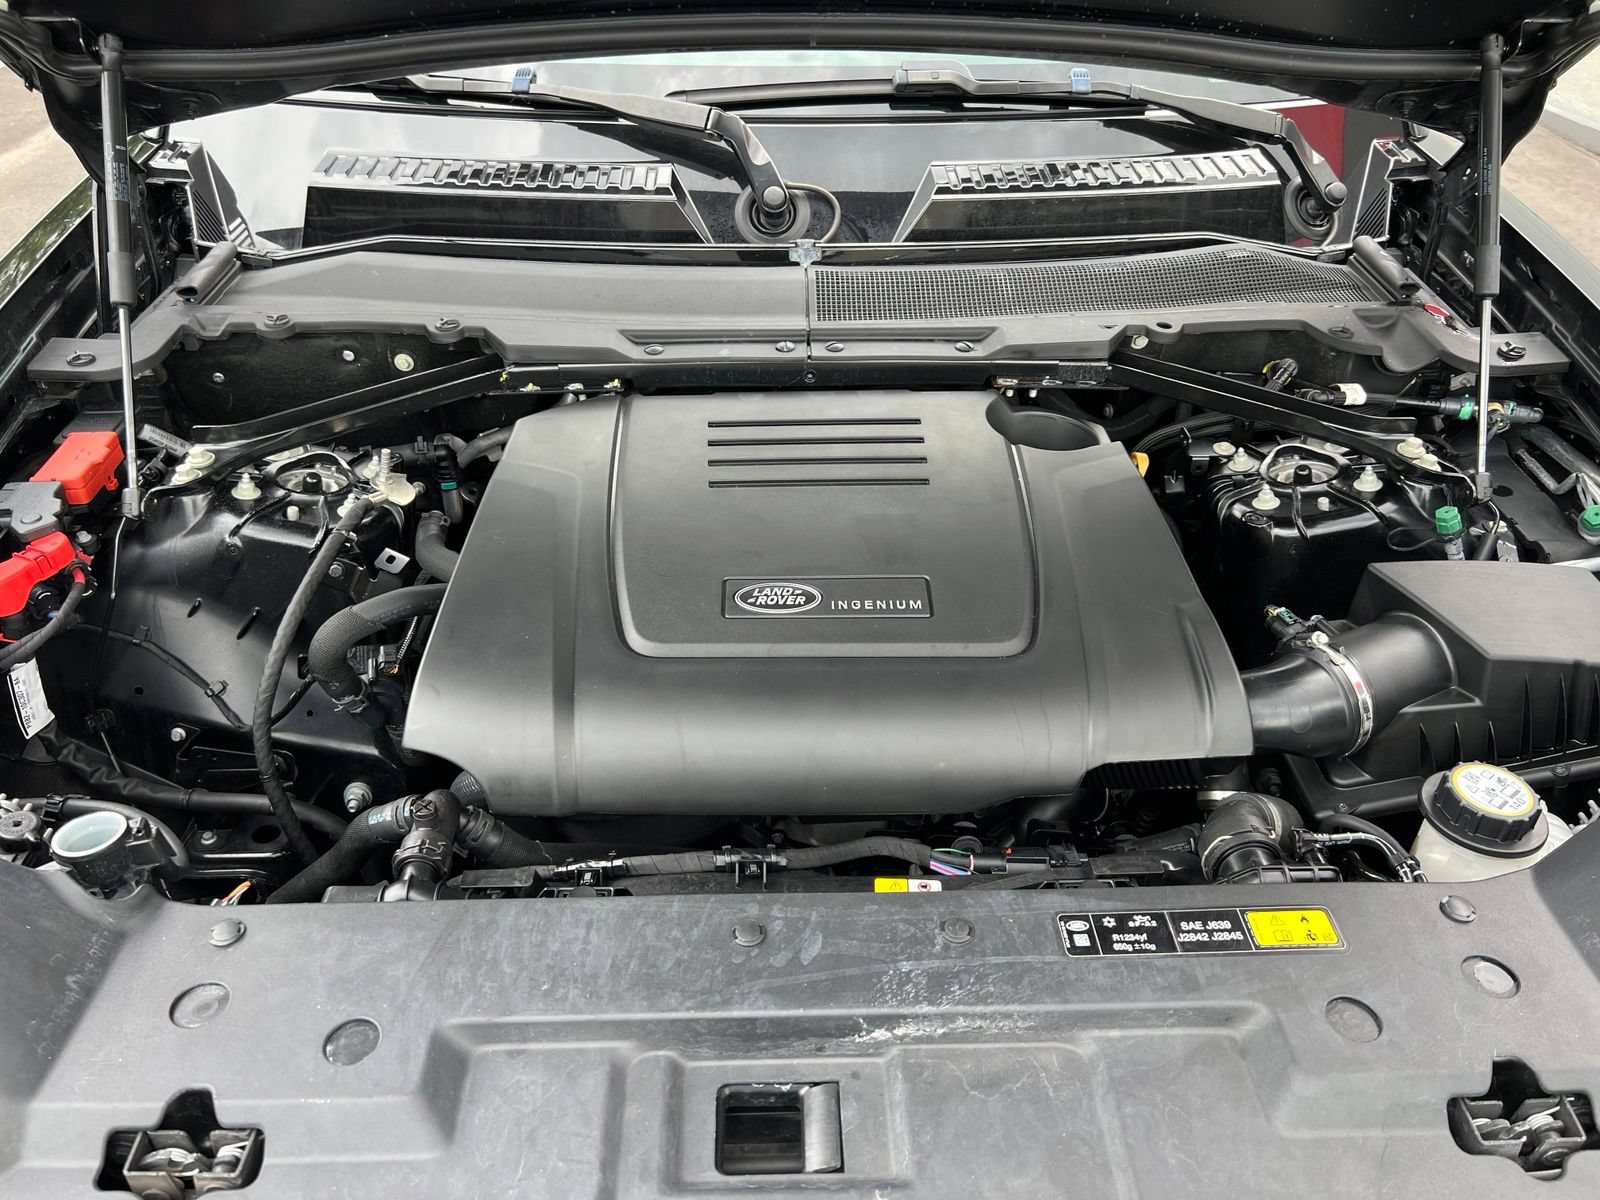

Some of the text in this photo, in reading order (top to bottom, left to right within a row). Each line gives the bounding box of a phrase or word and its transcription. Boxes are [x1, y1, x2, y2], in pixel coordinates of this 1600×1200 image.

[753, 587, 793, 597] LAND
[756, 595, 807, 606] ROVER
[831, 599, 922, 610] INGENIUM
[1180, 920, 1231, 930] SAE J639
[1112, 933, 1147, 942] R1234yf
[1177, 931, 1244, 942] J2842 J2845
